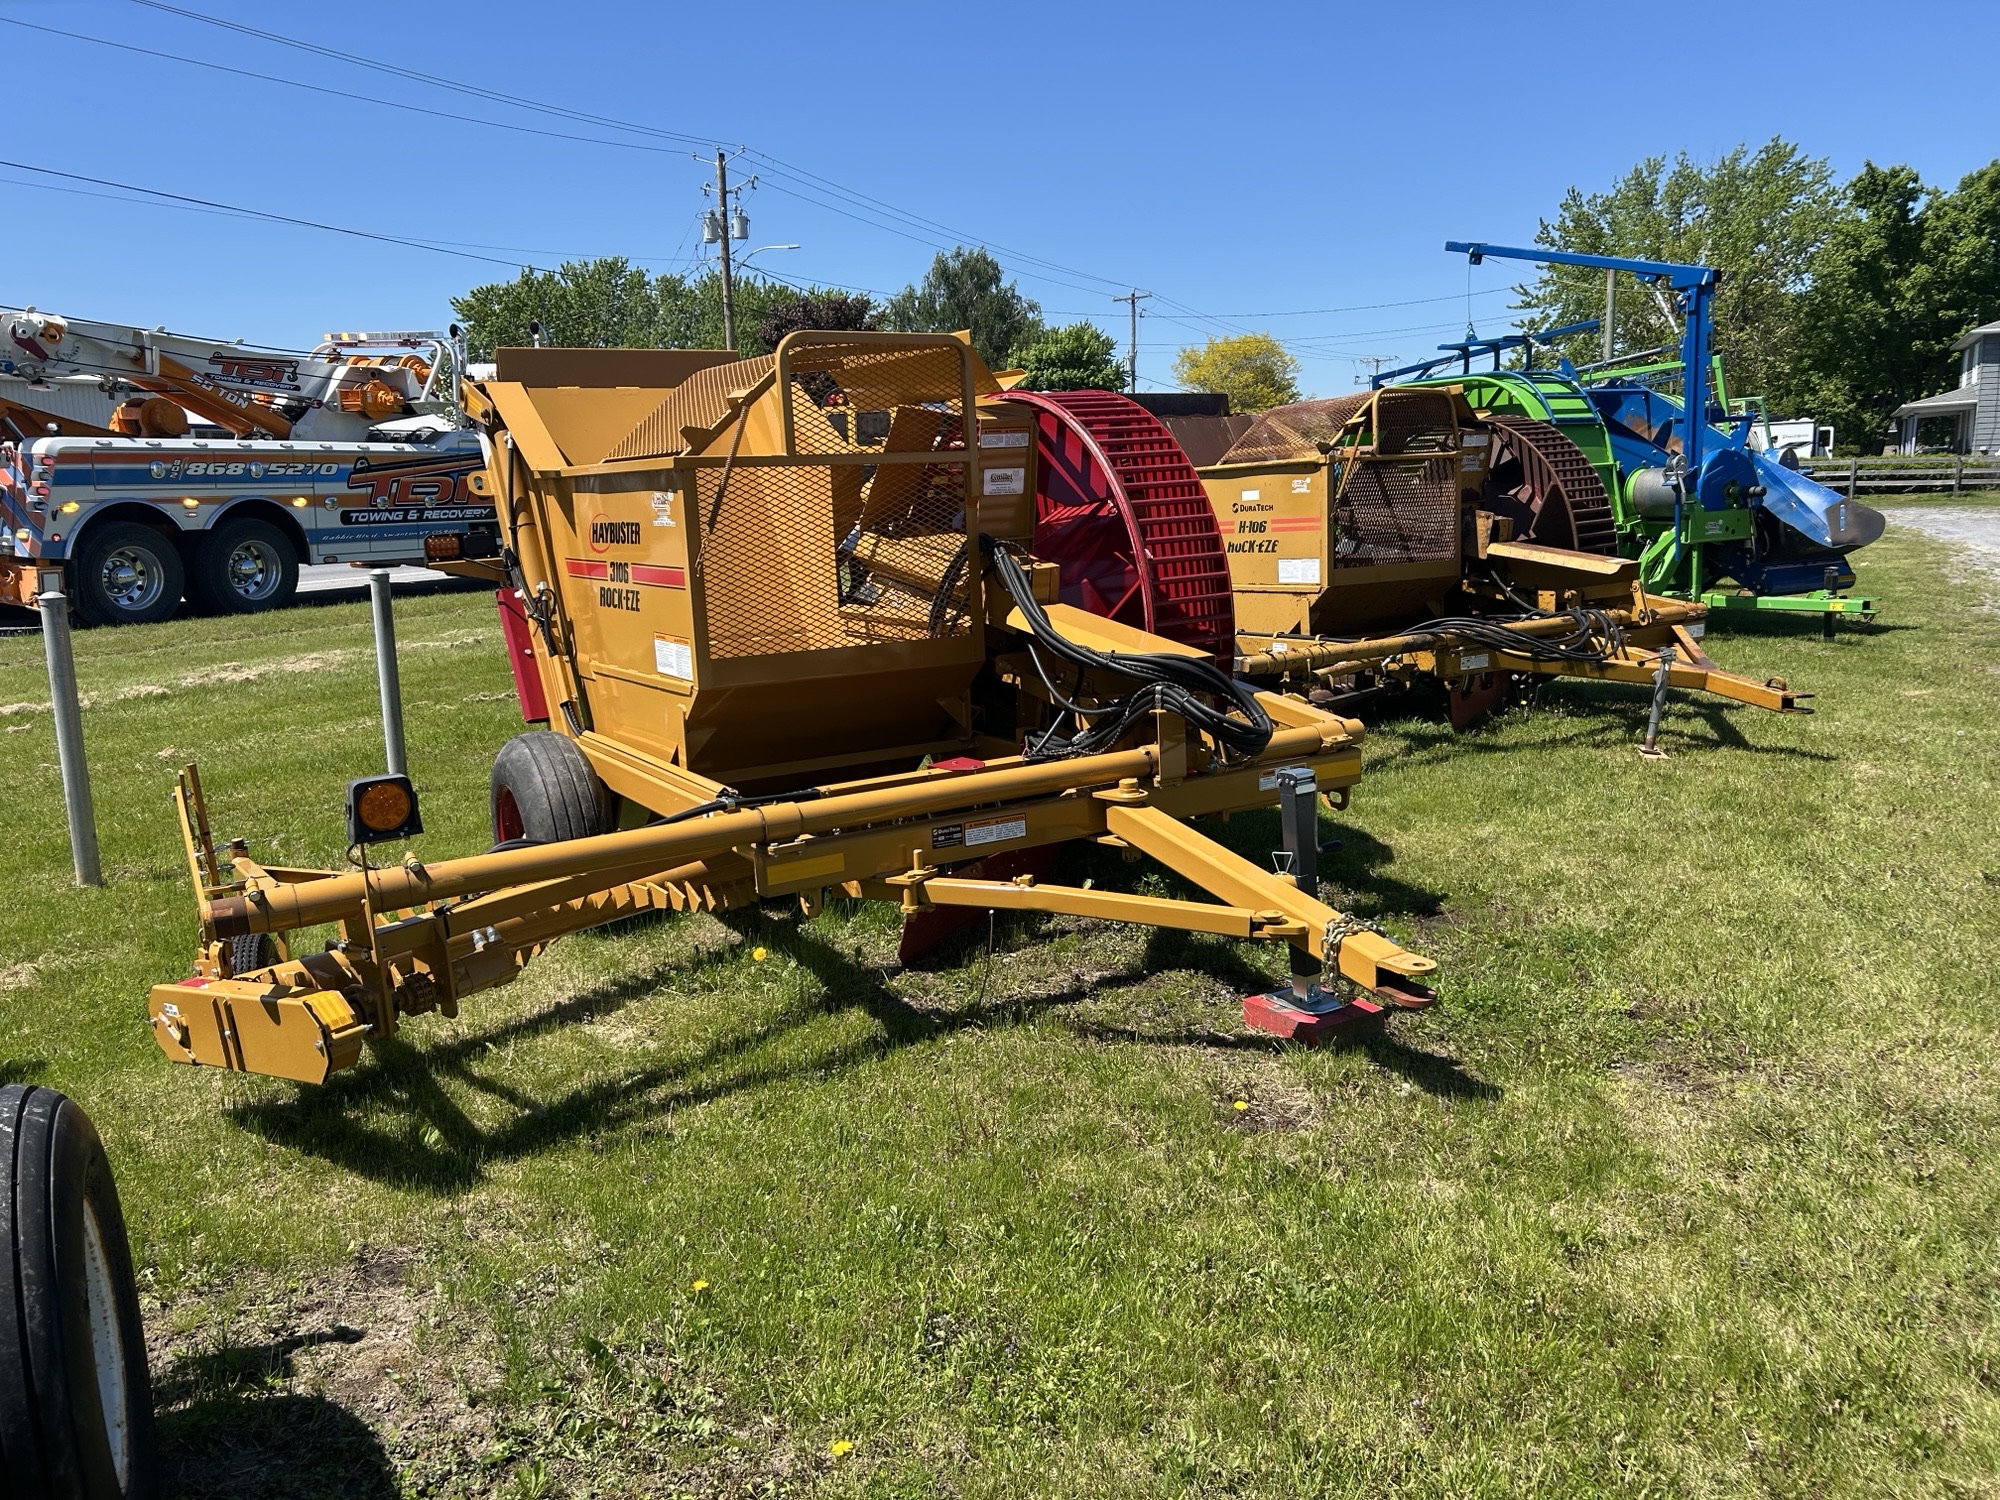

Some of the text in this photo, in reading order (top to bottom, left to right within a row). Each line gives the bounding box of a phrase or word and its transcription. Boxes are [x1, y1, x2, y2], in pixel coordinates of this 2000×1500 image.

[210, 373, 242, 383] TOWING
[253, 380, 296, 390] RECOVERY
[216, 388, 249, 409] TON
[186, 461, 340, 476] 868 5270
[350, 508, 490, 522] TOWING & RECOVERY
[592, 522, 641, 544] HAYBUSTER
[1238, 520, 1268, 534] H-106
[609, 561, 629, 584] 3106
